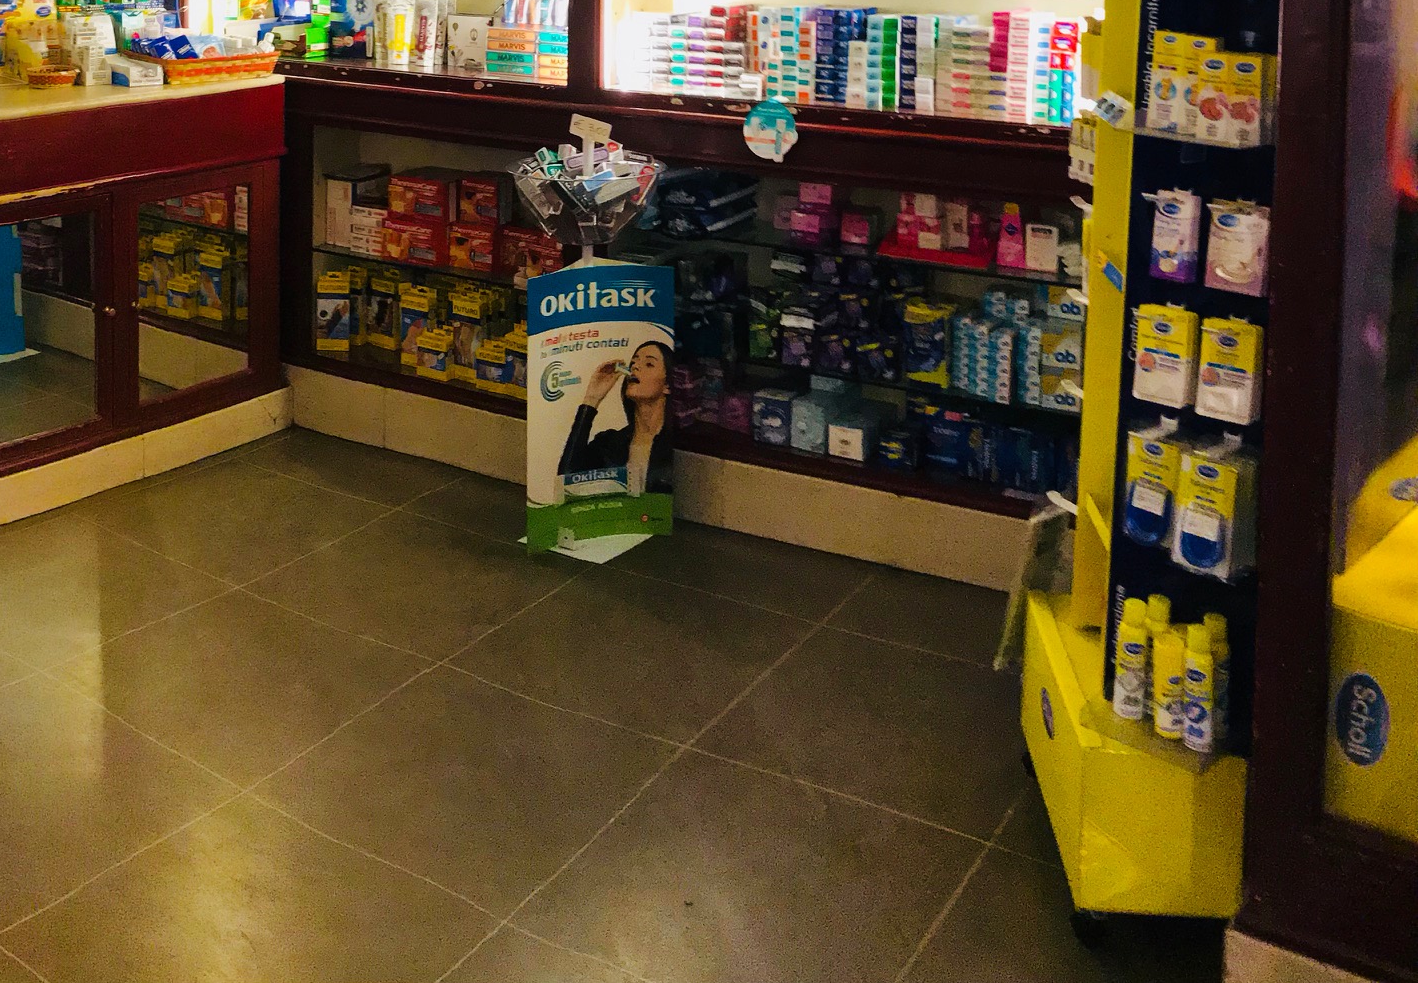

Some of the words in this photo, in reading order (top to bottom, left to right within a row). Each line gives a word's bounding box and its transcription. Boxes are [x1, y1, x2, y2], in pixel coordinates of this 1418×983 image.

[498, 42, 526, 51] MARVIS
[568, 329, 600, 342] testa
[585, 337, 629, 350] contati
